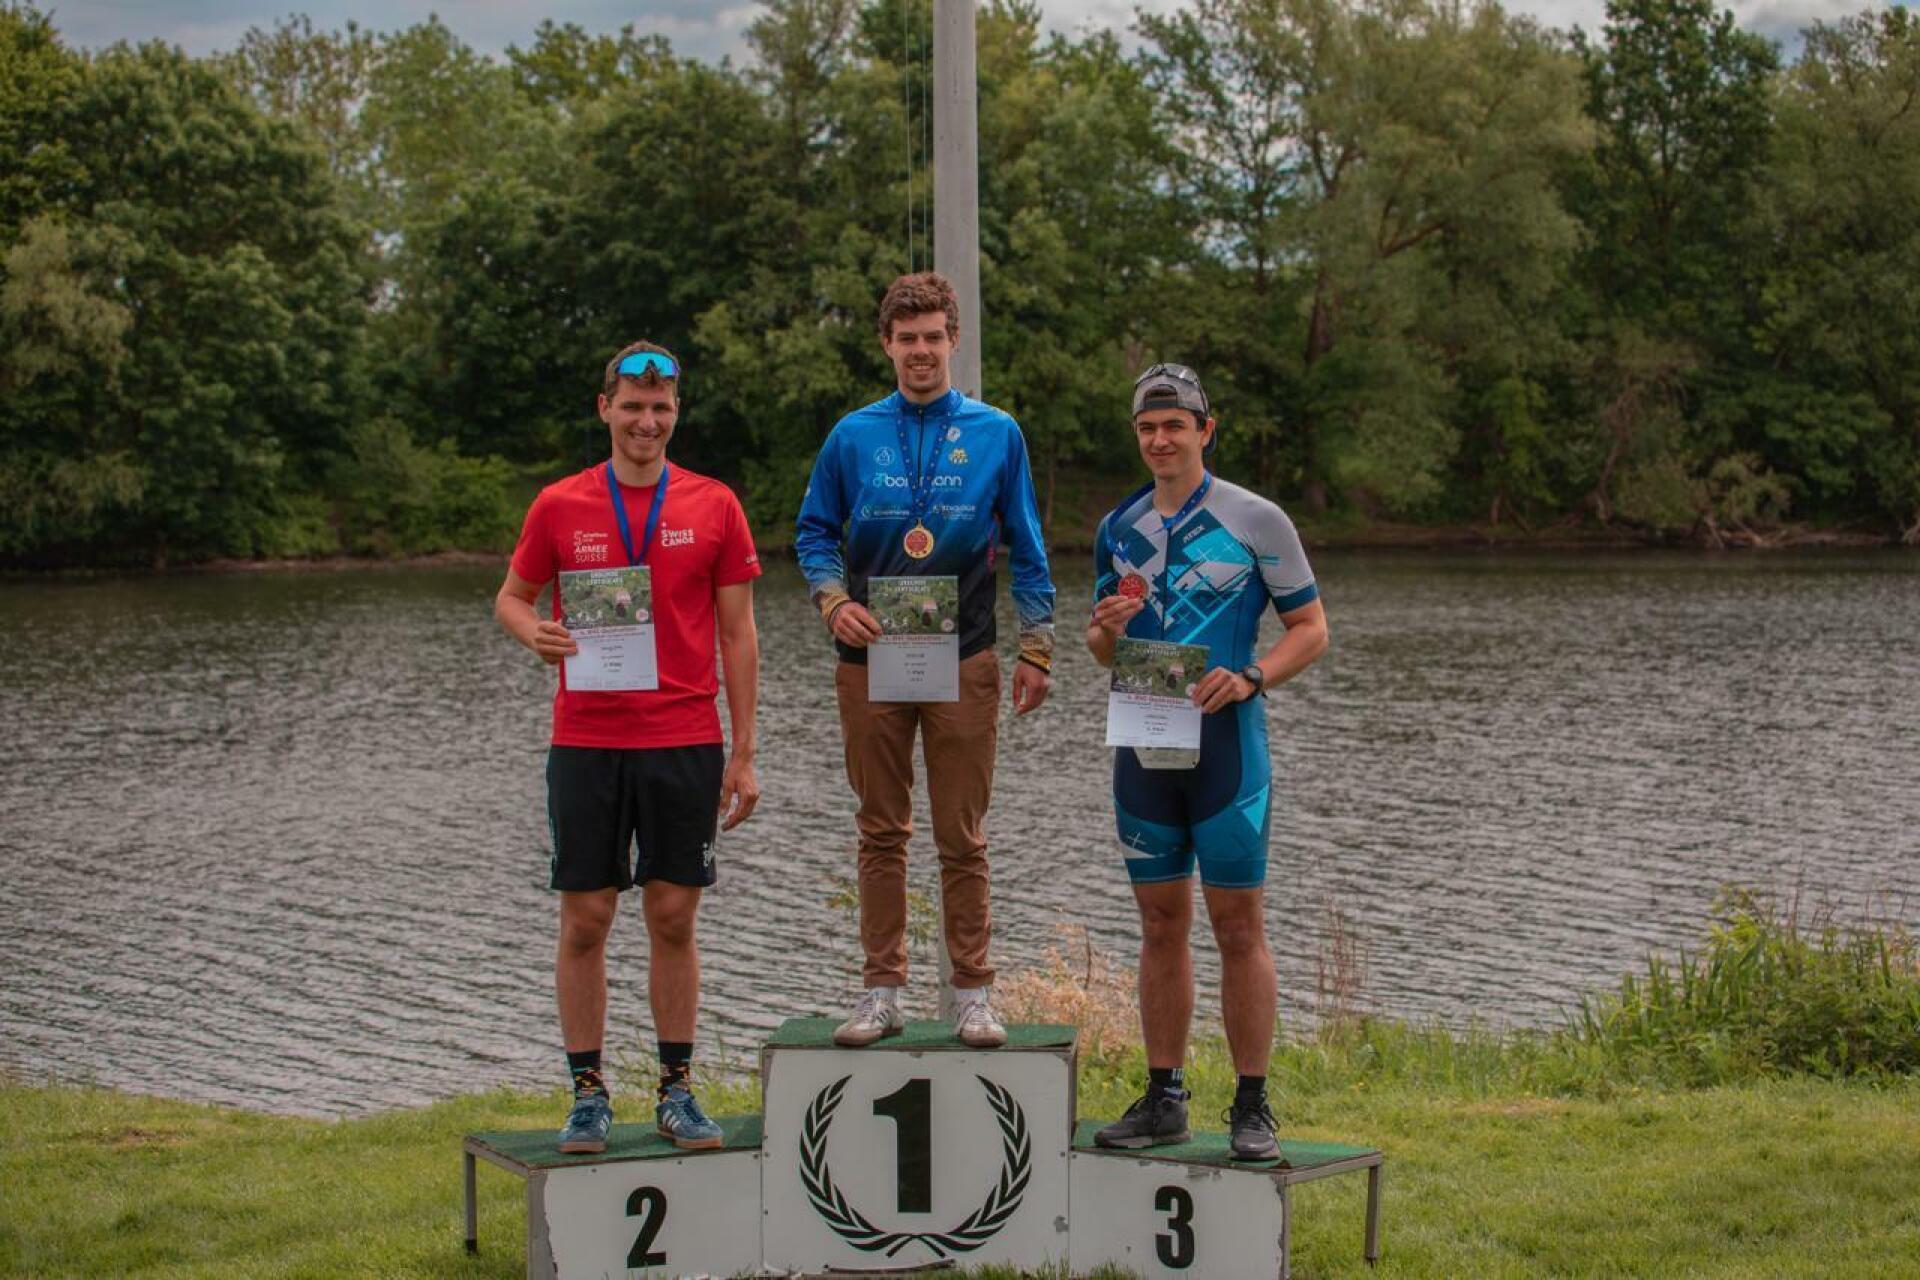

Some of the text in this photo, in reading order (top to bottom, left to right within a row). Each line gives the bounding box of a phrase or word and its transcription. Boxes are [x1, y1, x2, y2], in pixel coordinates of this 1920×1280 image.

[661, 528, 694, 539] SWISS
[661, 536, 695, 547] CANOE
[575, 544, 608, 553] ARMEE
[575, 553, 608, 563] SUISSE
[873, 1079, 931, 1213] 1
[626, 1186, 667, 1268] 2
[1155, 1186, 1195, 1269] 3
